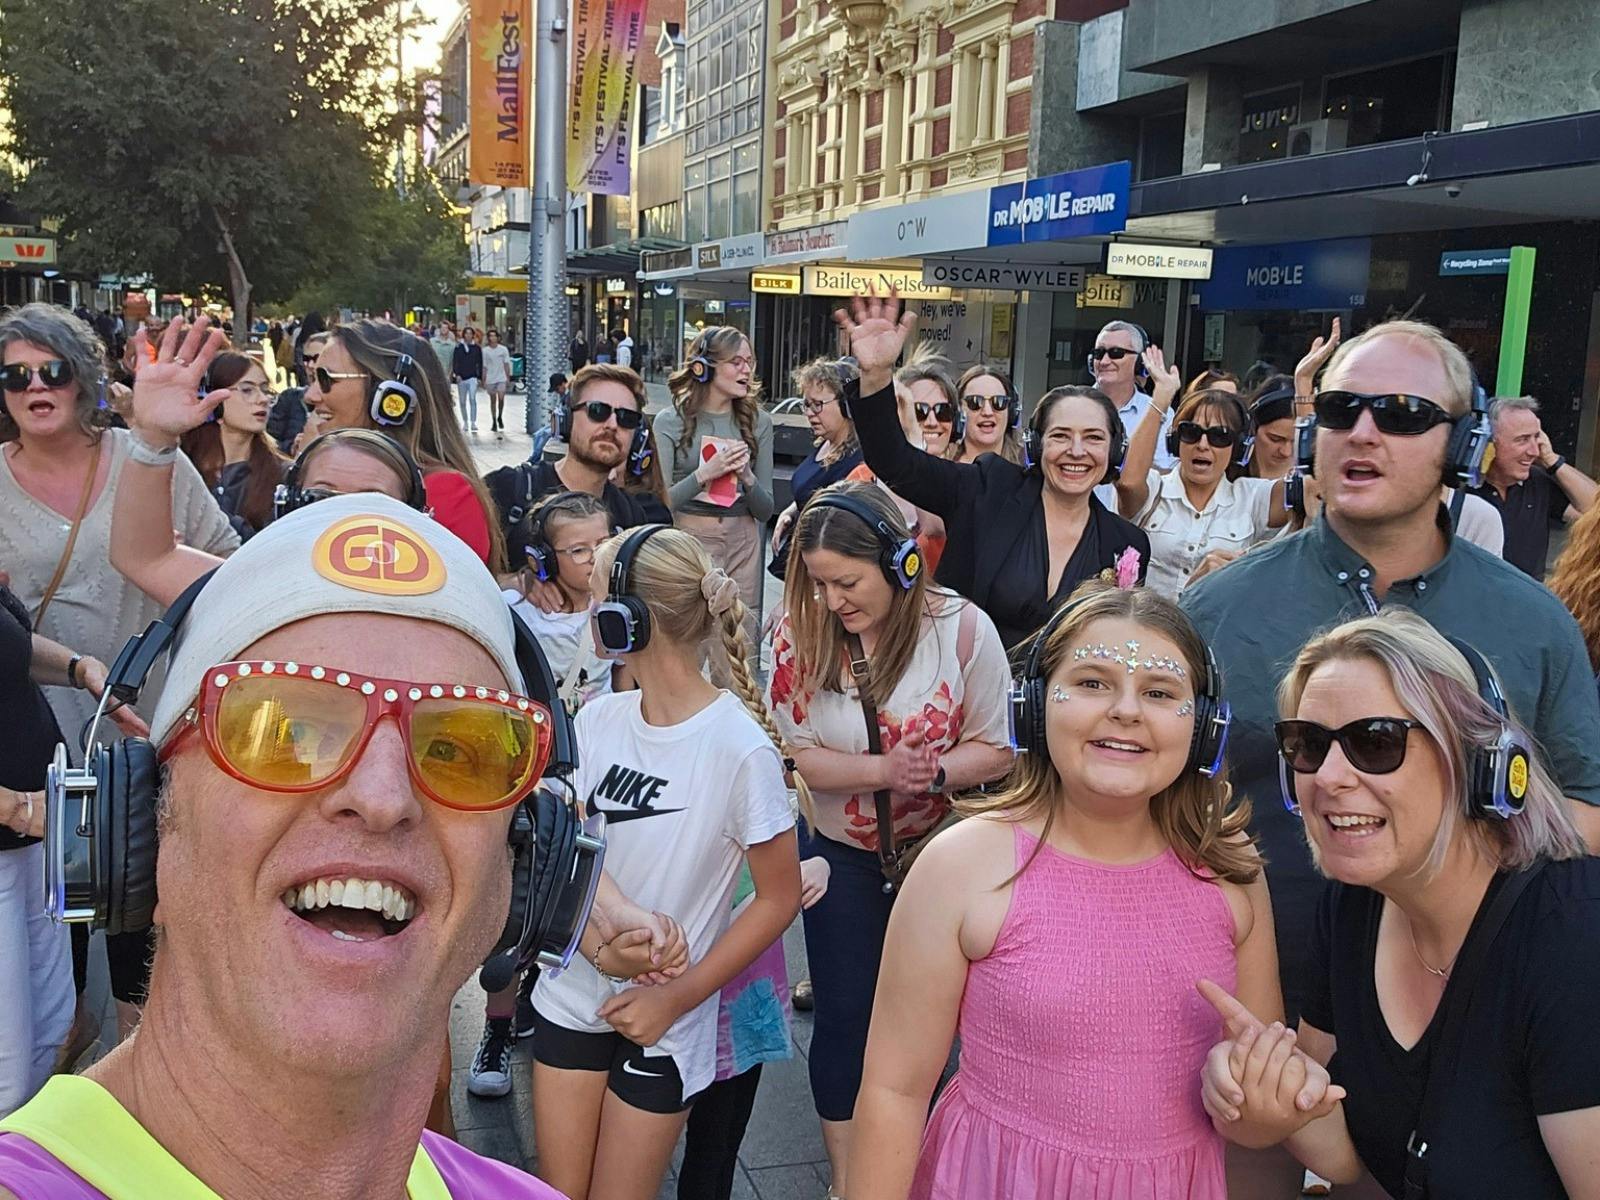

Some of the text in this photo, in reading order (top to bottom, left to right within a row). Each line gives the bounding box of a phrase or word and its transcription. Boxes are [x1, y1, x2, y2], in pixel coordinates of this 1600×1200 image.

[579, 0, 589, 25] TIM
[573, 28, 588, 107] FESTIVAL
[596, 44, 611, 122] FESTIVAL
[604, 0, 616, 41] TIME
[496, 10, 520, 144] MallFest
[616, 12, 640, 165] IT'S FESTIVAL TIME
[993, 210, 1009, 228] DR
[1071, 192, 1116, 217] REPAIR
[700, 250, 718, 263] SILK
[1111, 255, 1124, 263] DR
[1177, 258, 1208, 269] REPAIR
[760, 279, 788, 288] SILK
[815, 270, 873, 295] Bailey
[921, 301, 967, 321] Hey, we've
[919, 324, 952, 341] moved!
[596, 763, 670, 811] NIKE
